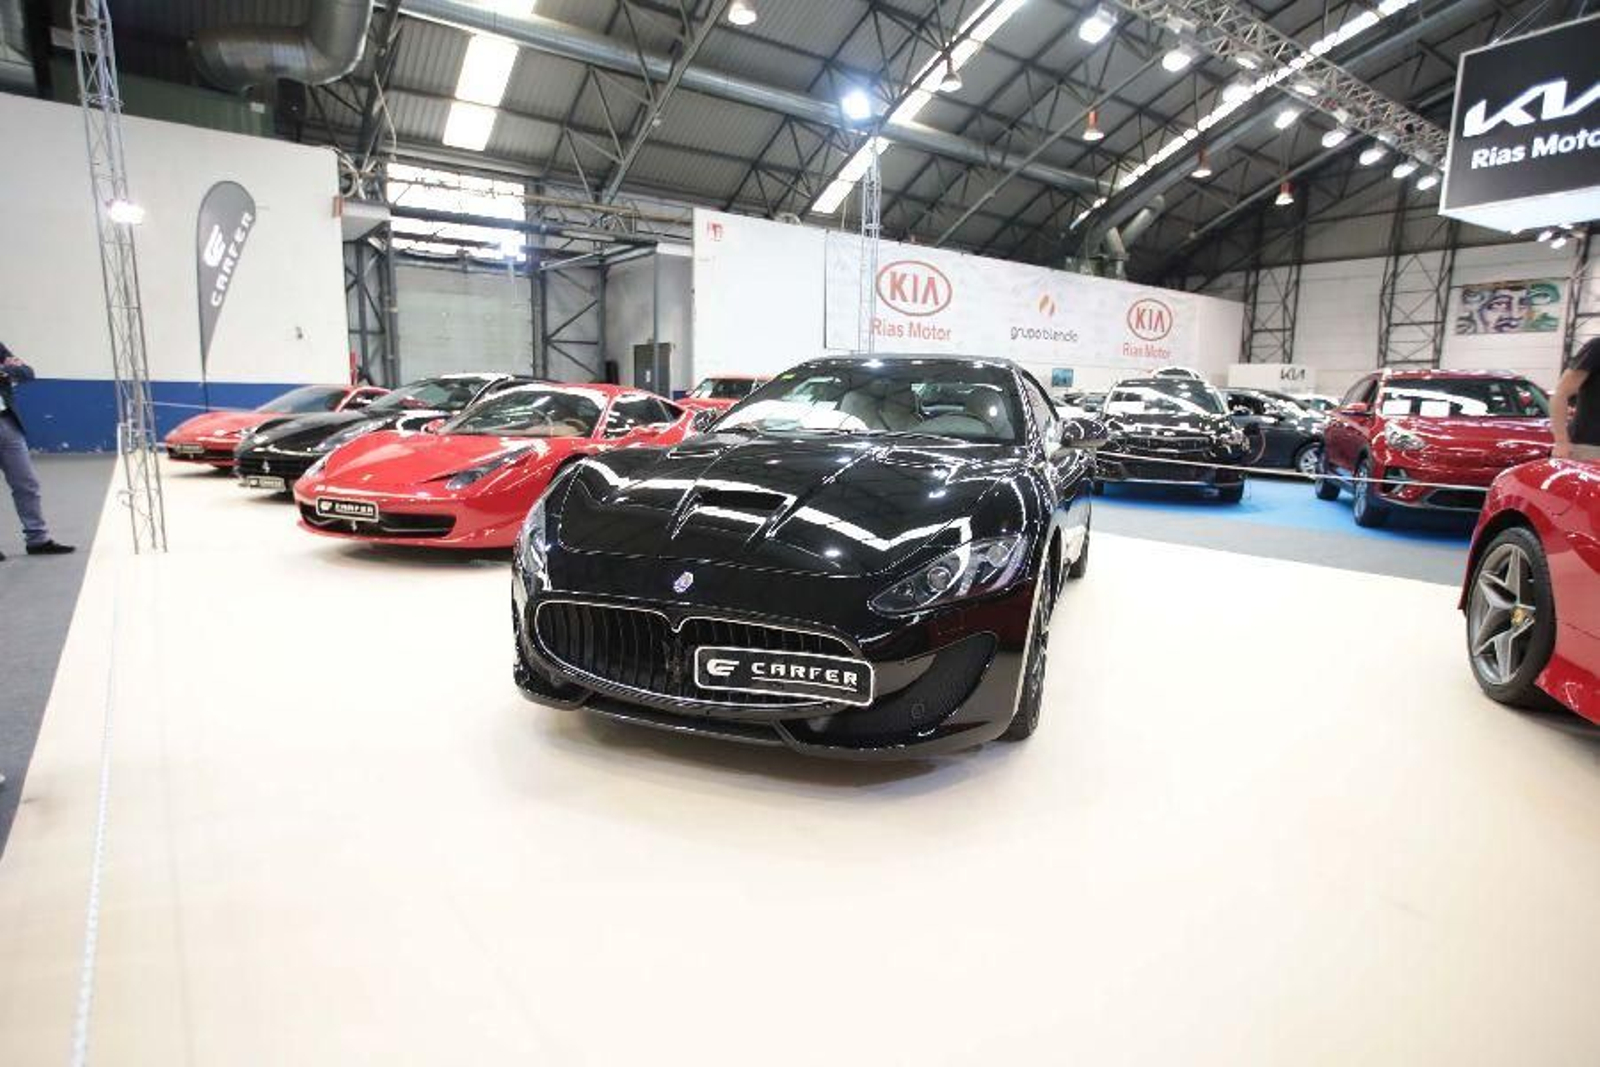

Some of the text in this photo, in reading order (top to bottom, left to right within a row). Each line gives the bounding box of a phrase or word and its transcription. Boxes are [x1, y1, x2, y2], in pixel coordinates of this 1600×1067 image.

[210, 212, 253, 307] CARFER
[889, 271, 939, 306] KIA
[909, 321, 952, 341] Motor
[1135, 306, 1165, 333] KIA
[751, 662, 858, 687] CARFER
